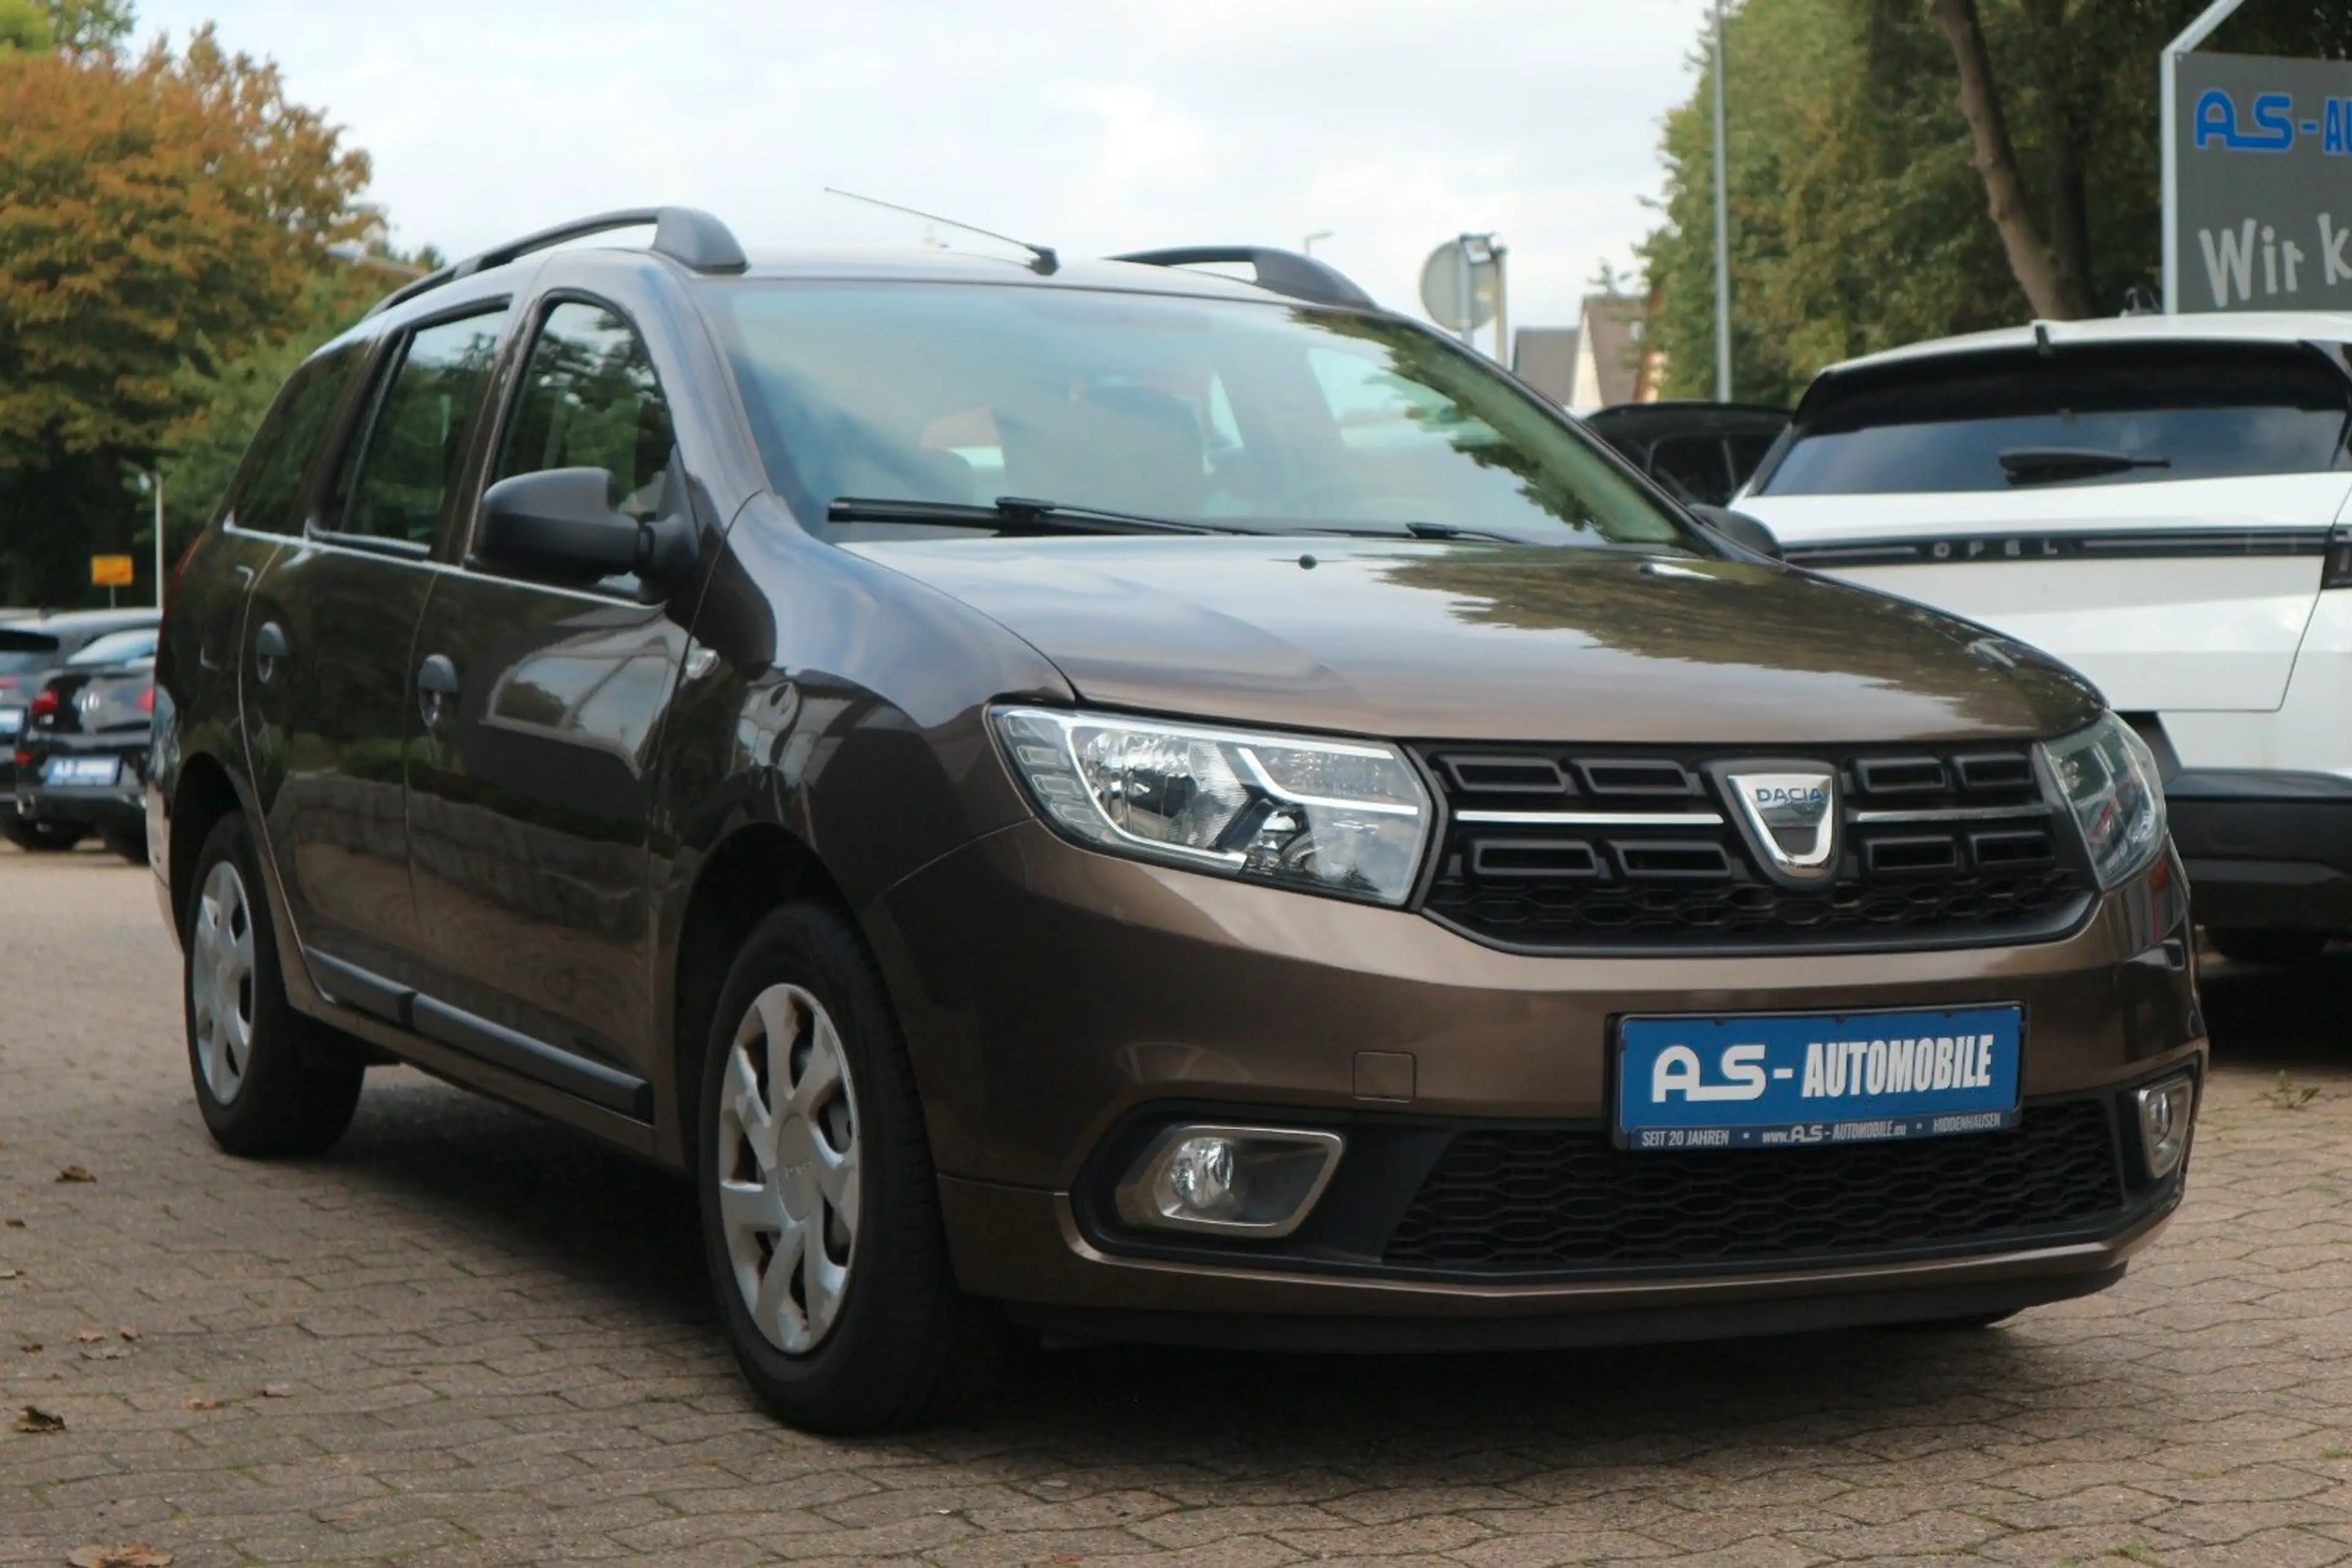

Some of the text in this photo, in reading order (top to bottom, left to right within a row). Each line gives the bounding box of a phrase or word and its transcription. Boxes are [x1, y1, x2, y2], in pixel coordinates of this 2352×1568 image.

[2198, 217, 2305, 308] Wir
[1933, 538, 2059, 559] OPEL
[1755, 787, 1825, 803] DACIA
[1650, 1033, 1994, 1104] AS-AUTOMOBILE
[1642, 1130, 1667, 1147] SEIT
[1668, 1131, 1684, 1146] 20
[1686, 1129, 1730, 1146] JAHREN
[1932, 1112, 2002, 1133] HIDDENHAUSEN
